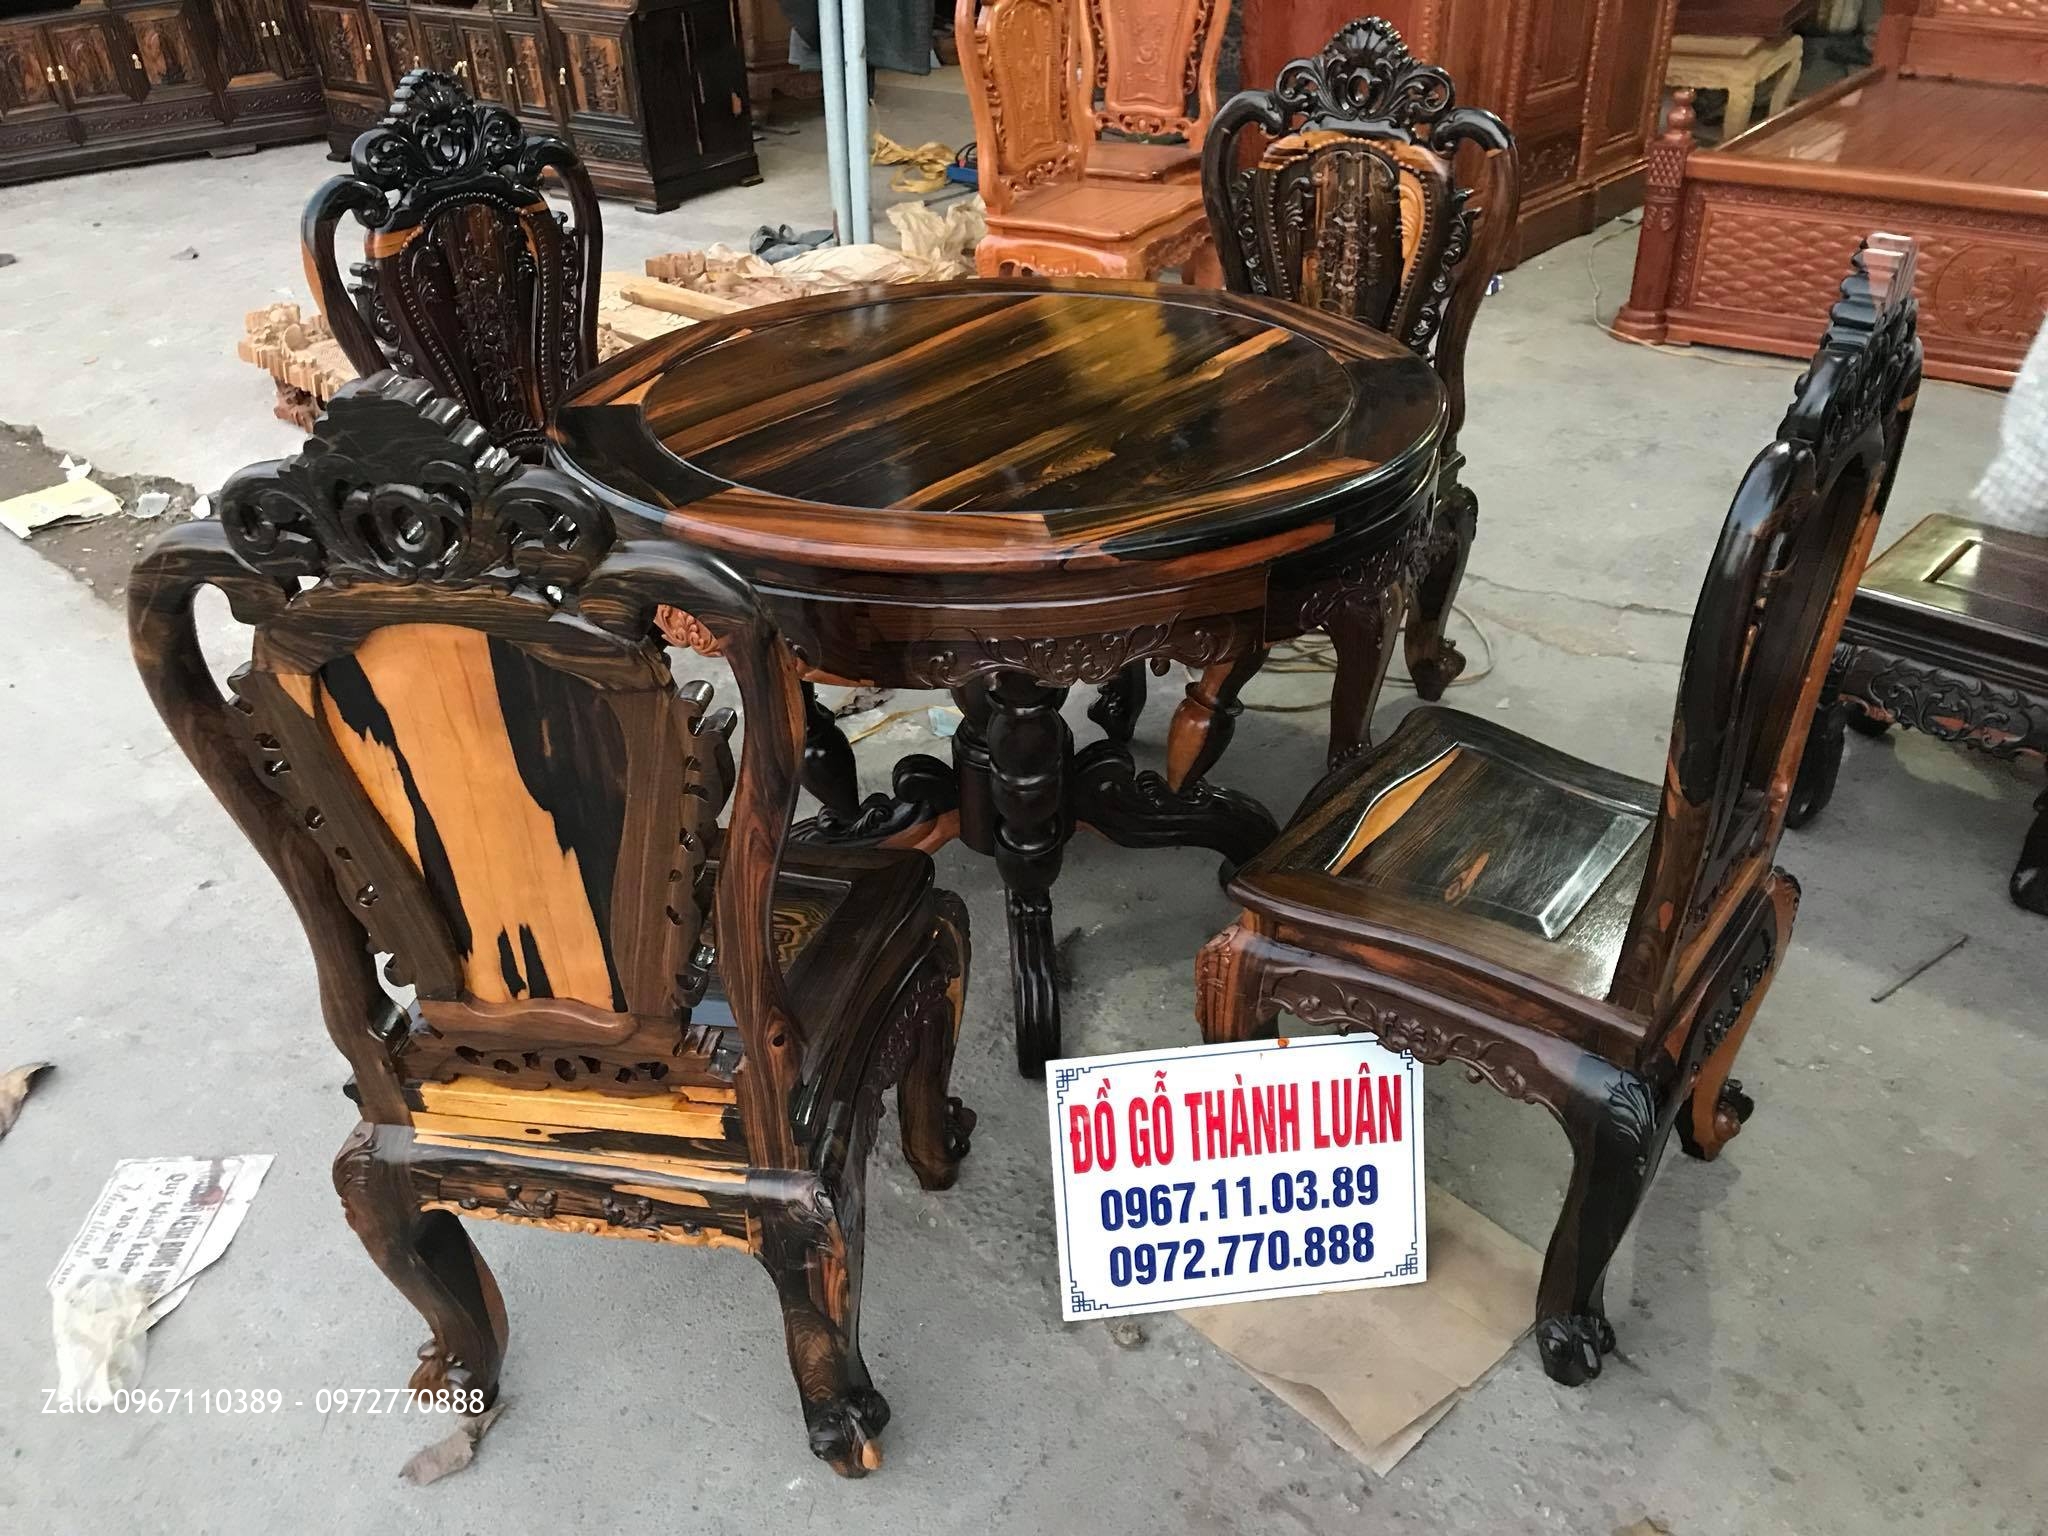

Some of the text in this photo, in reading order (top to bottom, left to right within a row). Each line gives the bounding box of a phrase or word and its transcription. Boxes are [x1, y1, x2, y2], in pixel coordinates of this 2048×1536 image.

[1070, 1062, 1402, 1174] ĐỒ GỖ THÀNH LUÂN
[1100, 1164, 1379, 1231] 0967.11.03.89
[1109, 1221, 1375, 1287] 0972.770.888
